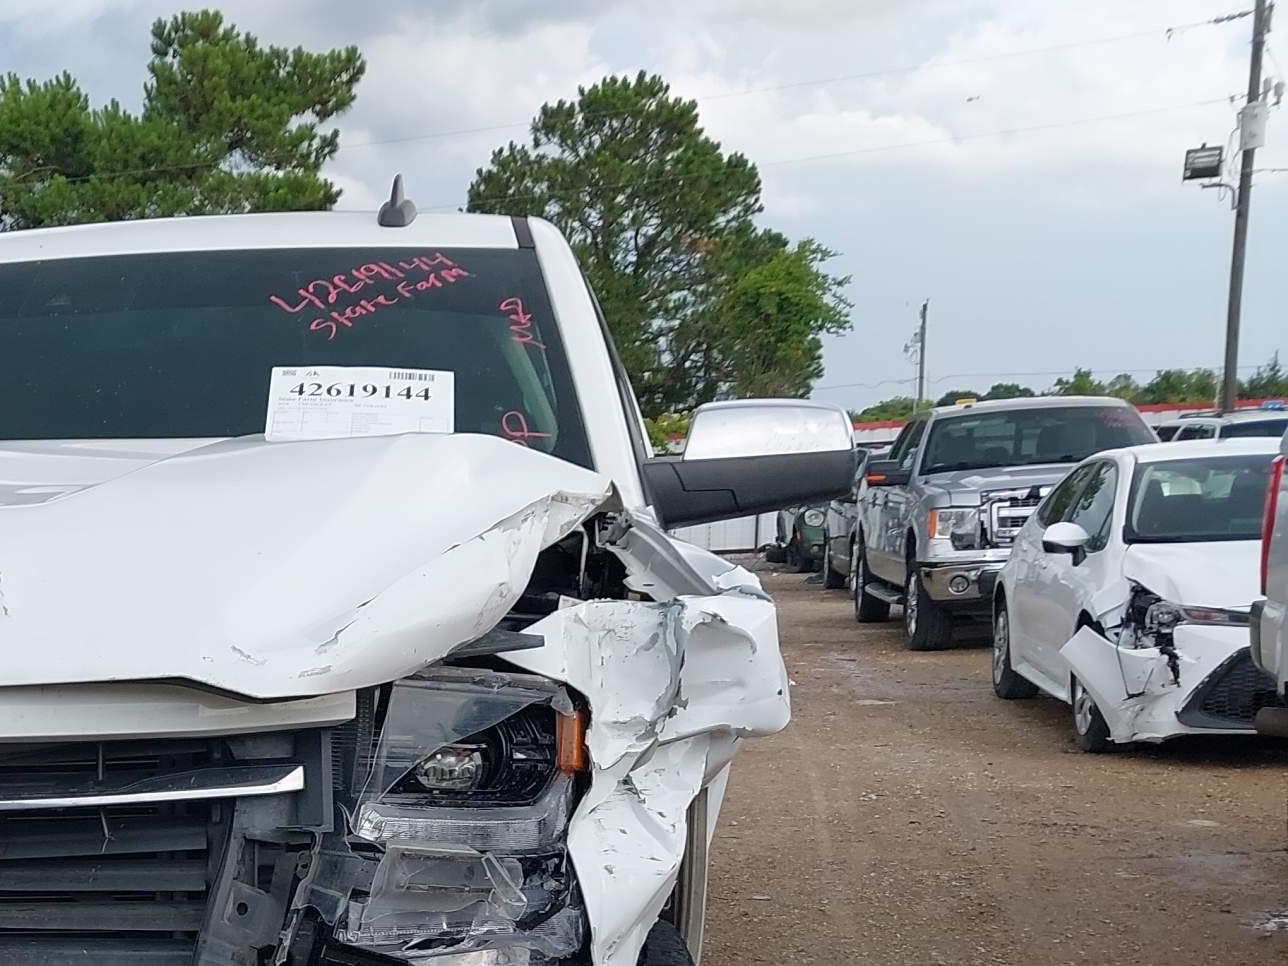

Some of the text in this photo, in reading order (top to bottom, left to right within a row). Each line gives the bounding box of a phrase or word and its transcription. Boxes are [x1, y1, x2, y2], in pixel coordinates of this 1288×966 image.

[269, 251, 456, 313] 42619144
[309, 293, 399, 341] State
[289, 381, 432, 402] 42619144
